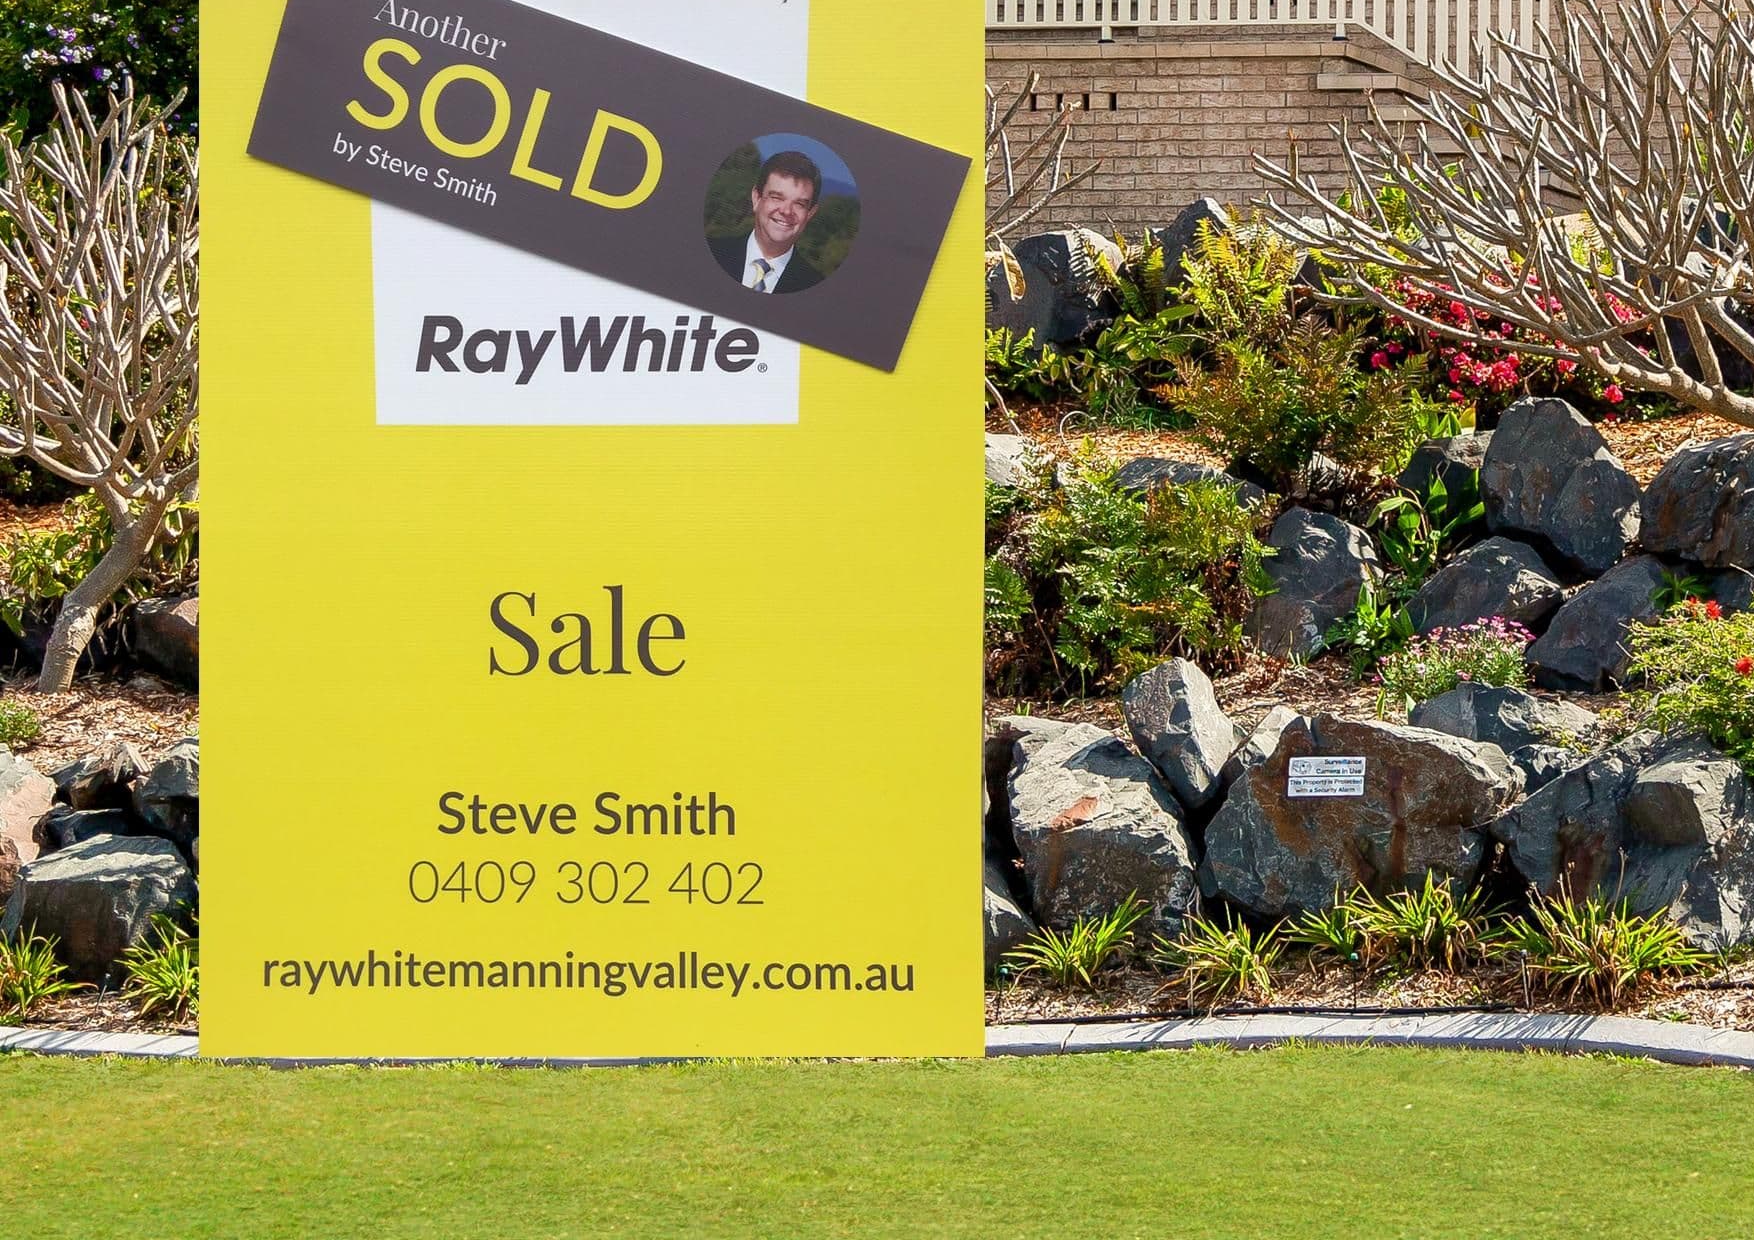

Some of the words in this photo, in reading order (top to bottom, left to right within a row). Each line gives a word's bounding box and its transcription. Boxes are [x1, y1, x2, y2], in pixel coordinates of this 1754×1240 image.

[345, 37, 664, 210] SOLD
[333, 132, 362, 162] by
[366, 145, 429, 182] Steve
[433, 167, 498, 207] Smith
[489, 585, 687, 677] Sale
[438, 791, 577, 835] Steve
[594, 791, 736, 836] Smith
[409, 861, 537, 905] 0409
[556, 861, 650, 905] 302
[667, 862, 764, 906] 402
[262, 950, 915, 998] raywhitemanningvalley.com.au
